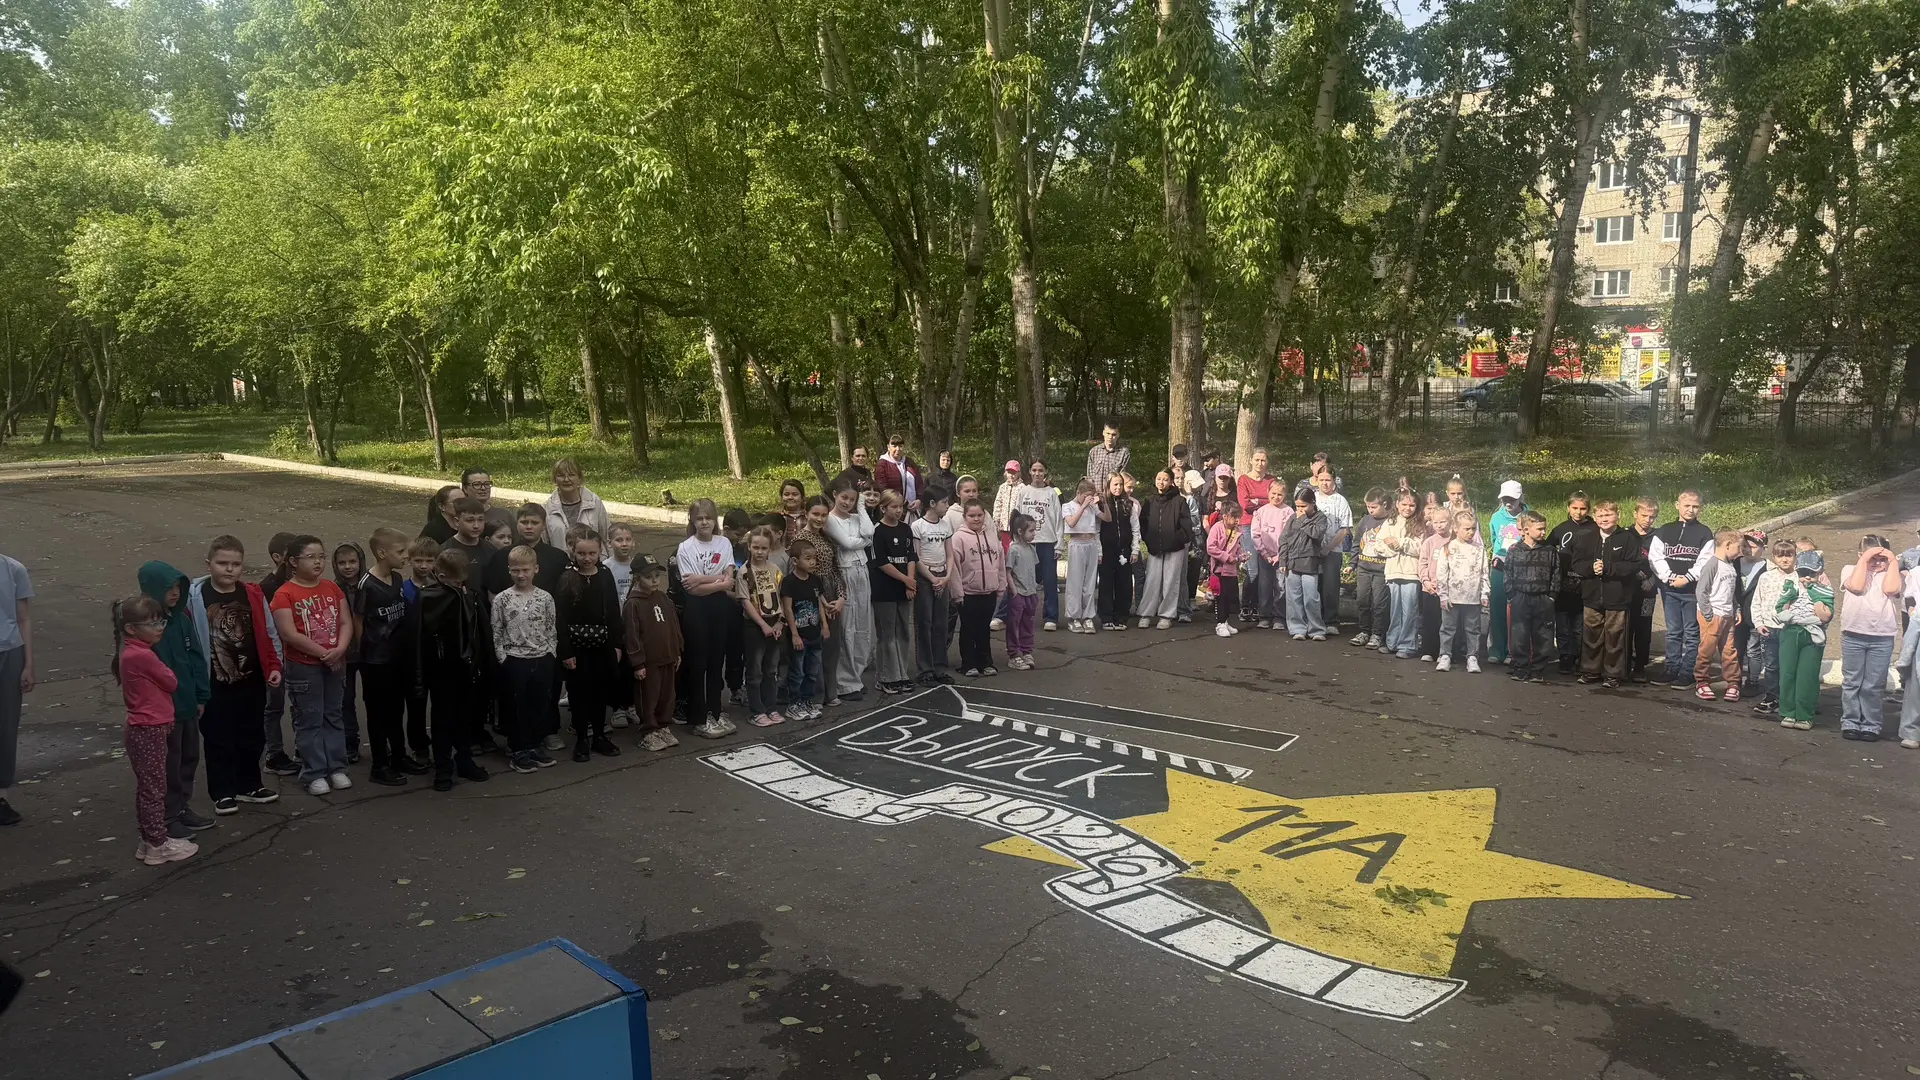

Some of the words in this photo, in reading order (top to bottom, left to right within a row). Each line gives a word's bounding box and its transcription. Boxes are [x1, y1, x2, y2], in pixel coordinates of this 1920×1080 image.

[1664, 543, 1700, 557] indness
[653, 604, 665, 622] R
[838, 714, 1154, 799] ВЫПУСК
[890, 790, 1169, 879] 2026
[1214, 804, 1408, 884] 11А
